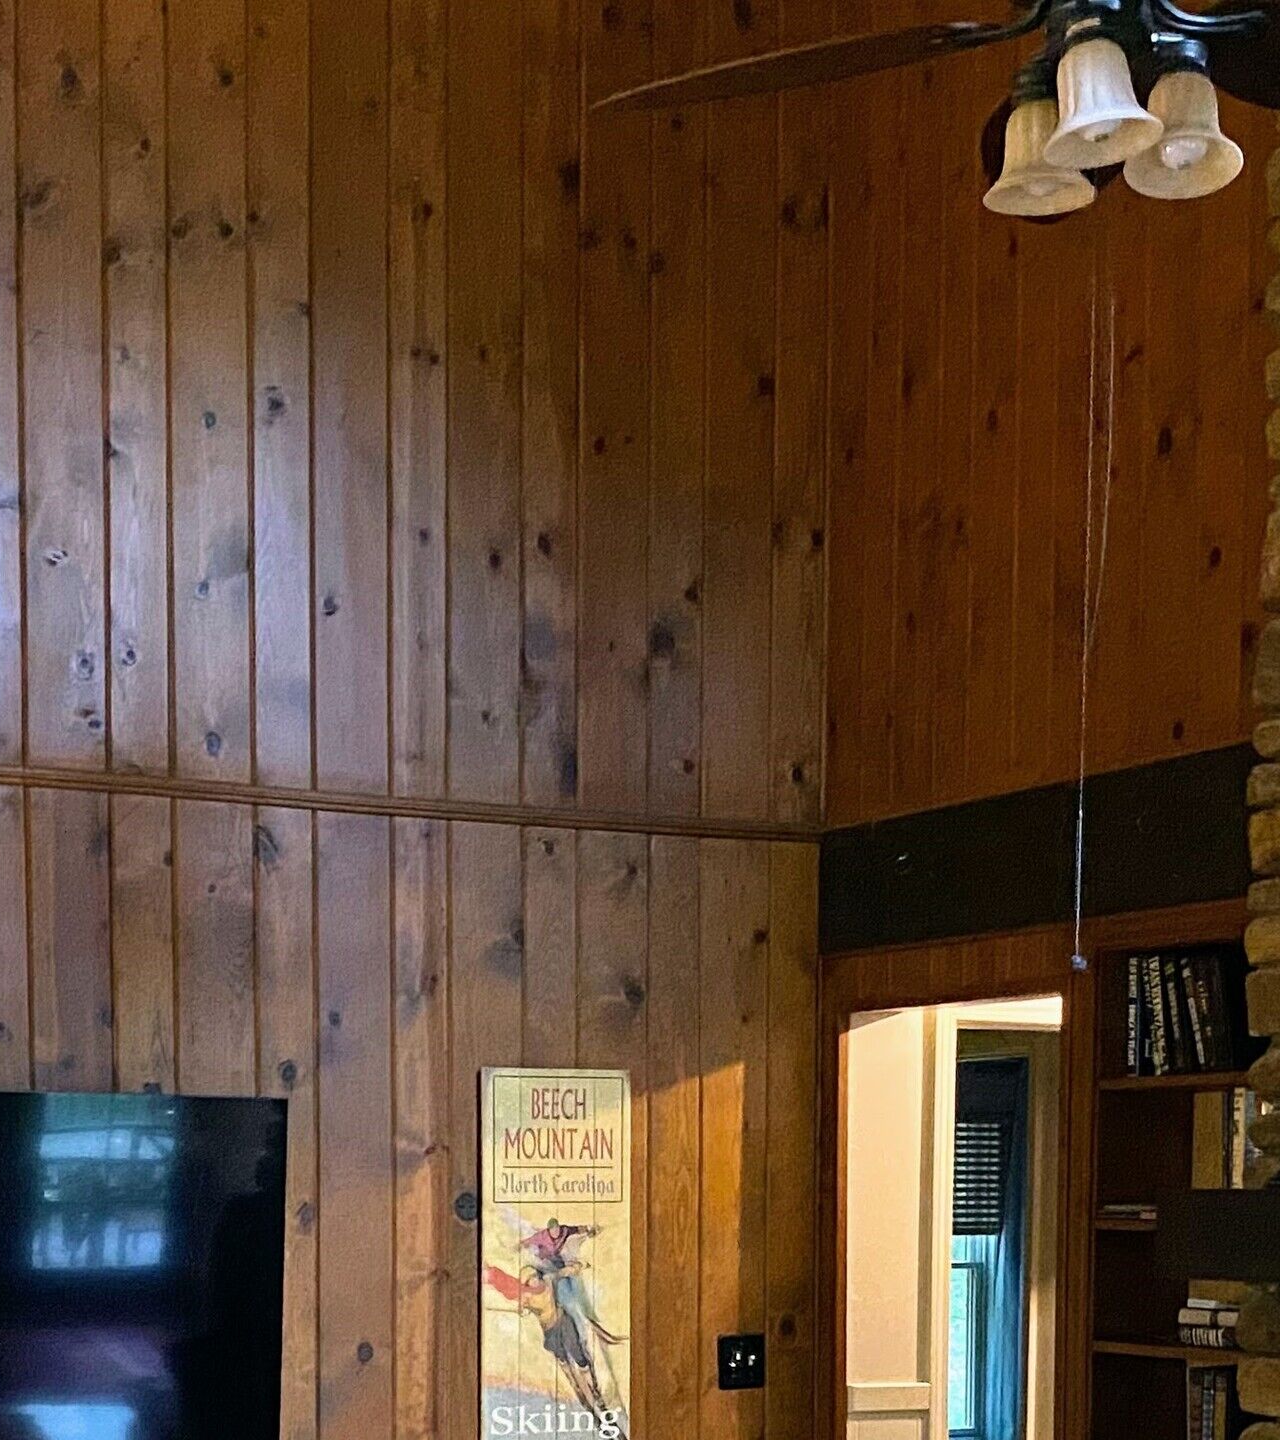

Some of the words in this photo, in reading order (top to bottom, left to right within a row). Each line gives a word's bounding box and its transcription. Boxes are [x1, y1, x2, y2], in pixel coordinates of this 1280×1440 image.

[531, 1088, 587, 1120] BEECH
[504, 1127, 614, 1160] MOUNTAIN
[500, 1172, 548, 1195] North
[552, 1173, 616, 1197] Carolina
[490, 1403, 622, 1439] Skiing
